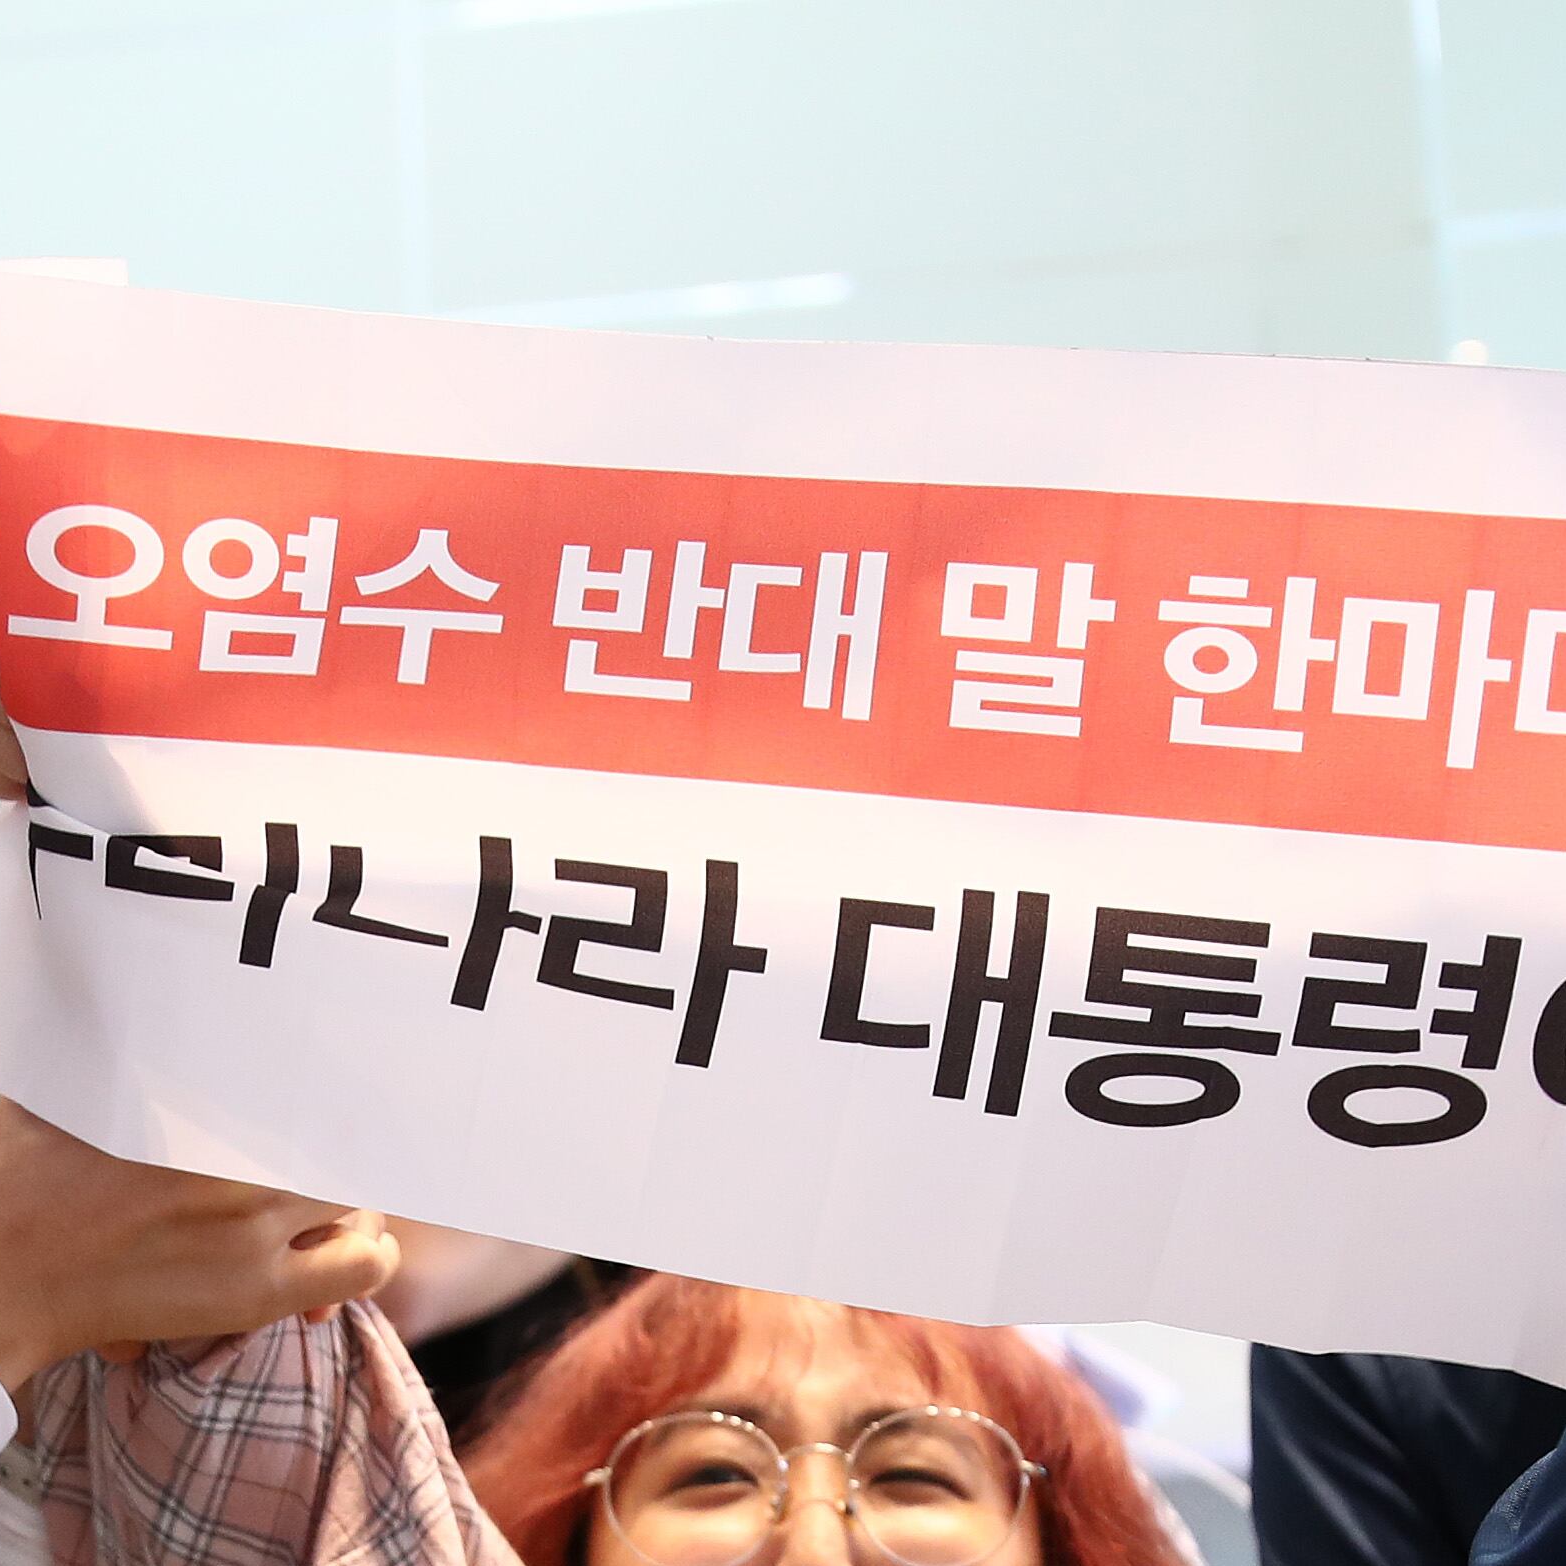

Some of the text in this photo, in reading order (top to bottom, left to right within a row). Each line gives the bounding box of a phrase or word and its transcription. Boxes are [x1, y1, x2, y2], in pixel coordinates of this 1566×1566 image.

[7, 503, 505, 685] 오염수
[551, 539, 890, 722] 반대
[940, 560, 1117, 738] 말
